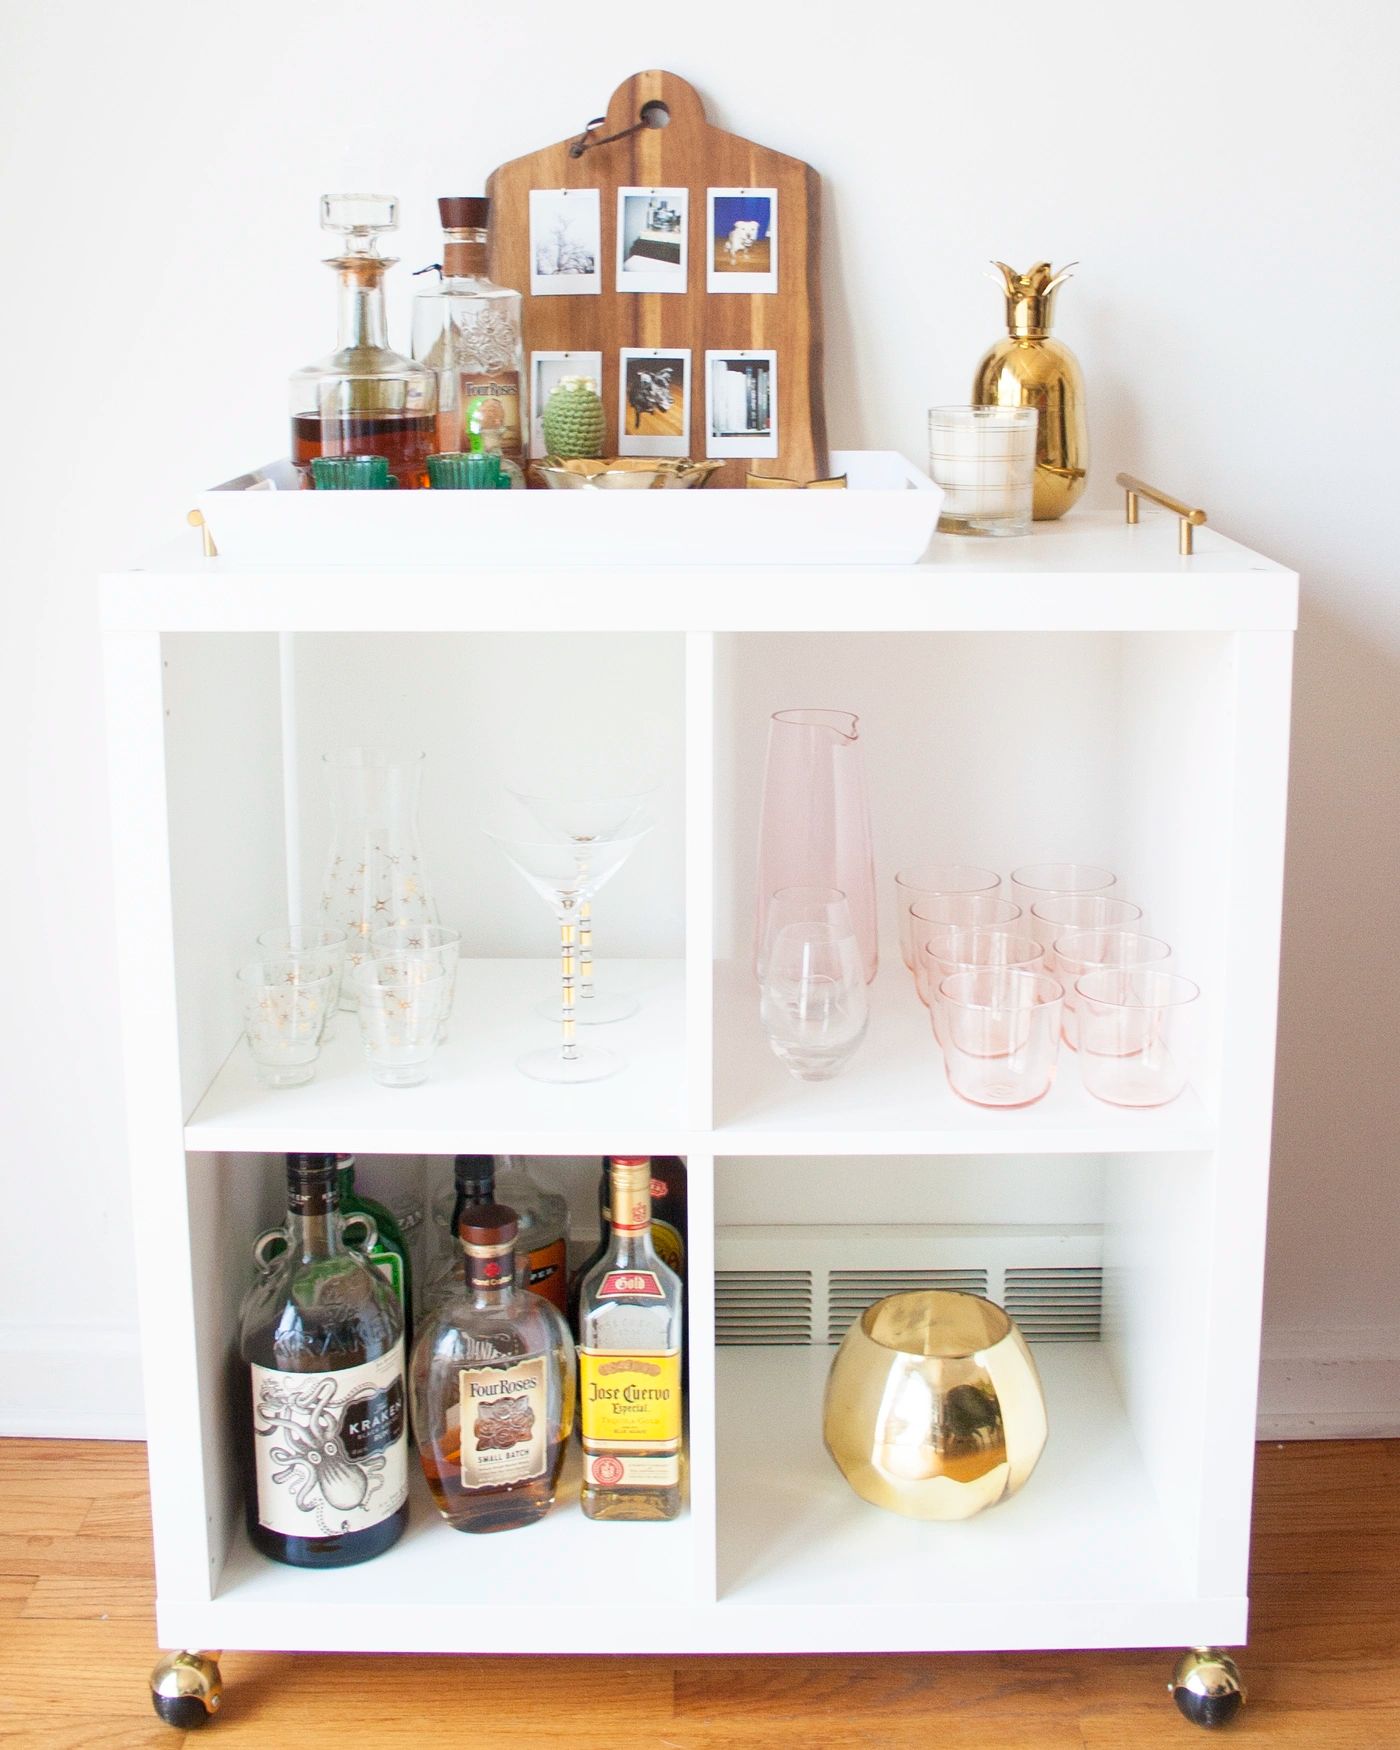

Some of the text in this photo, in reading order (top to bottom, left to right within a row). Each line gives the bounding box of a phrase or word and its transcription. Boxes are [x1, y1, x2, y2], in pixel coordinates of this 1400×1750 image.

[466, 382, 518, 396] Four Roses
[614, 1276, 646, 1290] Gold
[470, 1378, 537, 1398] Four Roses
[589, 1382, 670, 1403] Jose Cuervo
[478, 1449, 530, 1464] SMALL BATCH
